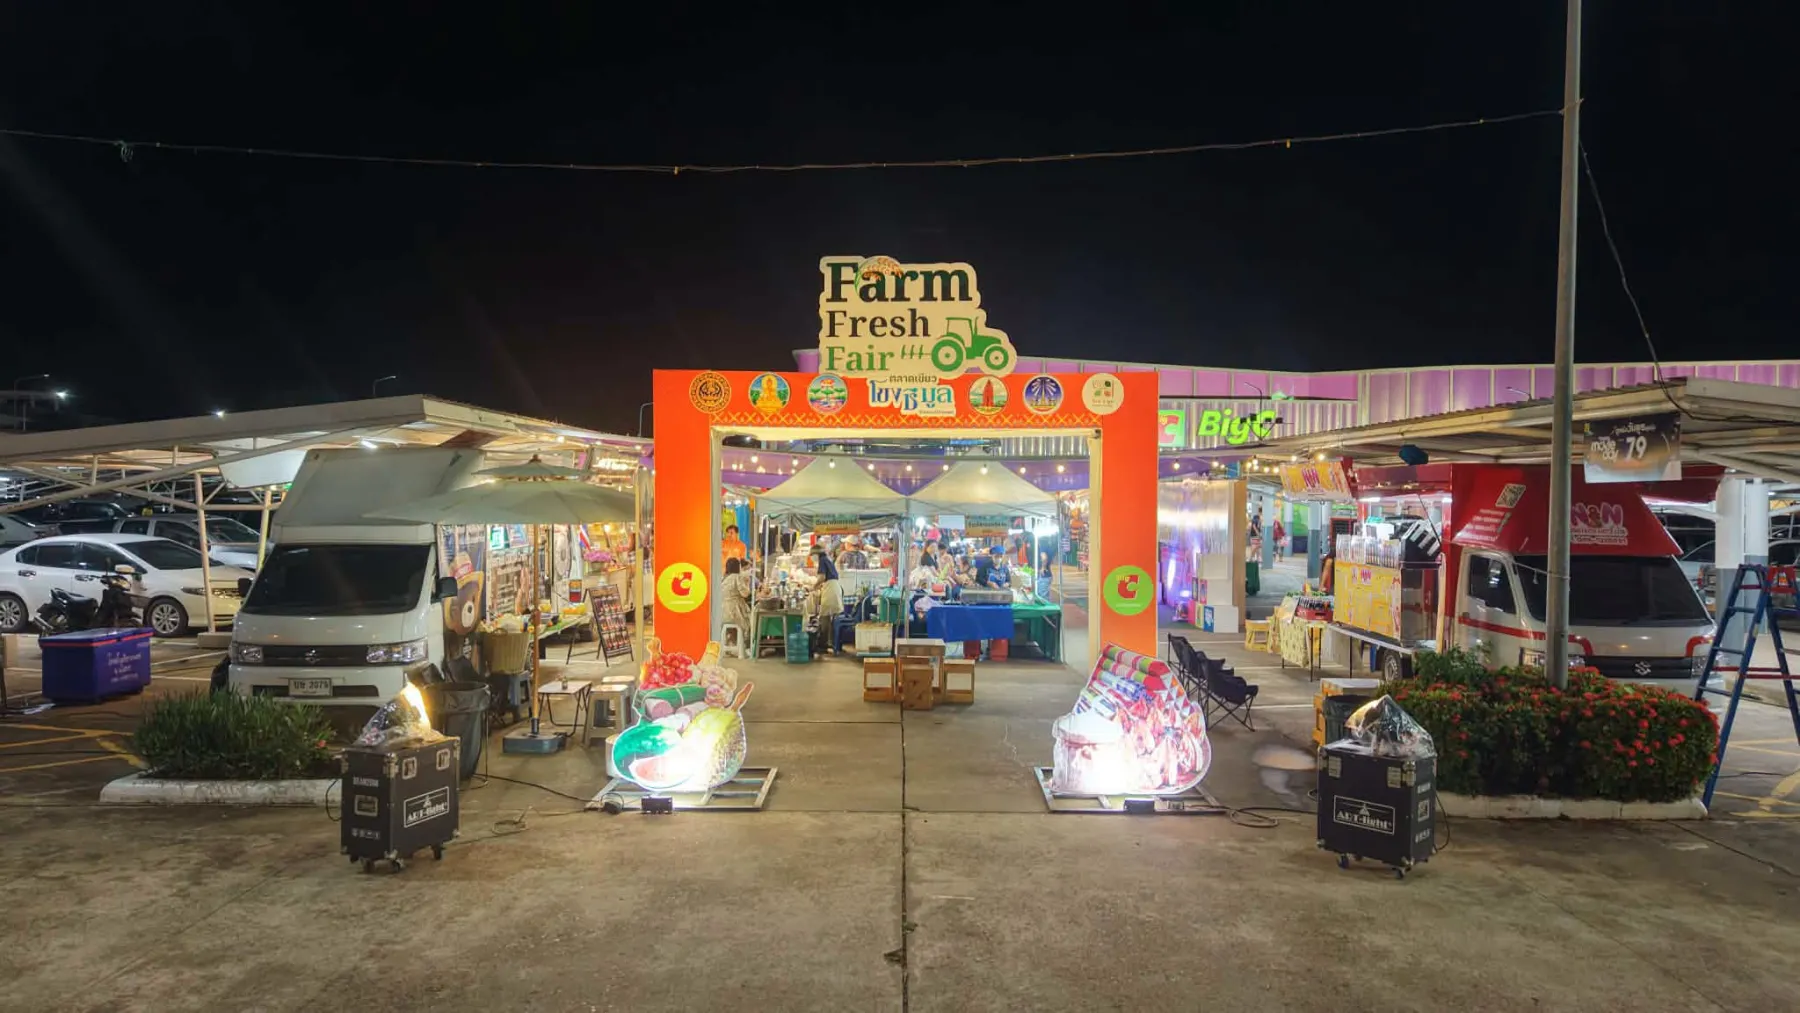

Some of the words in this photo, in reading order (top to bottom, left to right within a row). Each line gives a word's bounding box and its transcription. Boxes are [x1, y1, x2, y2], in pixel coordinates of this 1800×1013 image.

[826, 262, 972, 302] Farm
[826, 308, 931, 337] Fresh
[826, 344, 894, 371] Fair
[889, 373, 937, 383] ตลาดเขียว
[1626, 435, 1647, 461] 79
